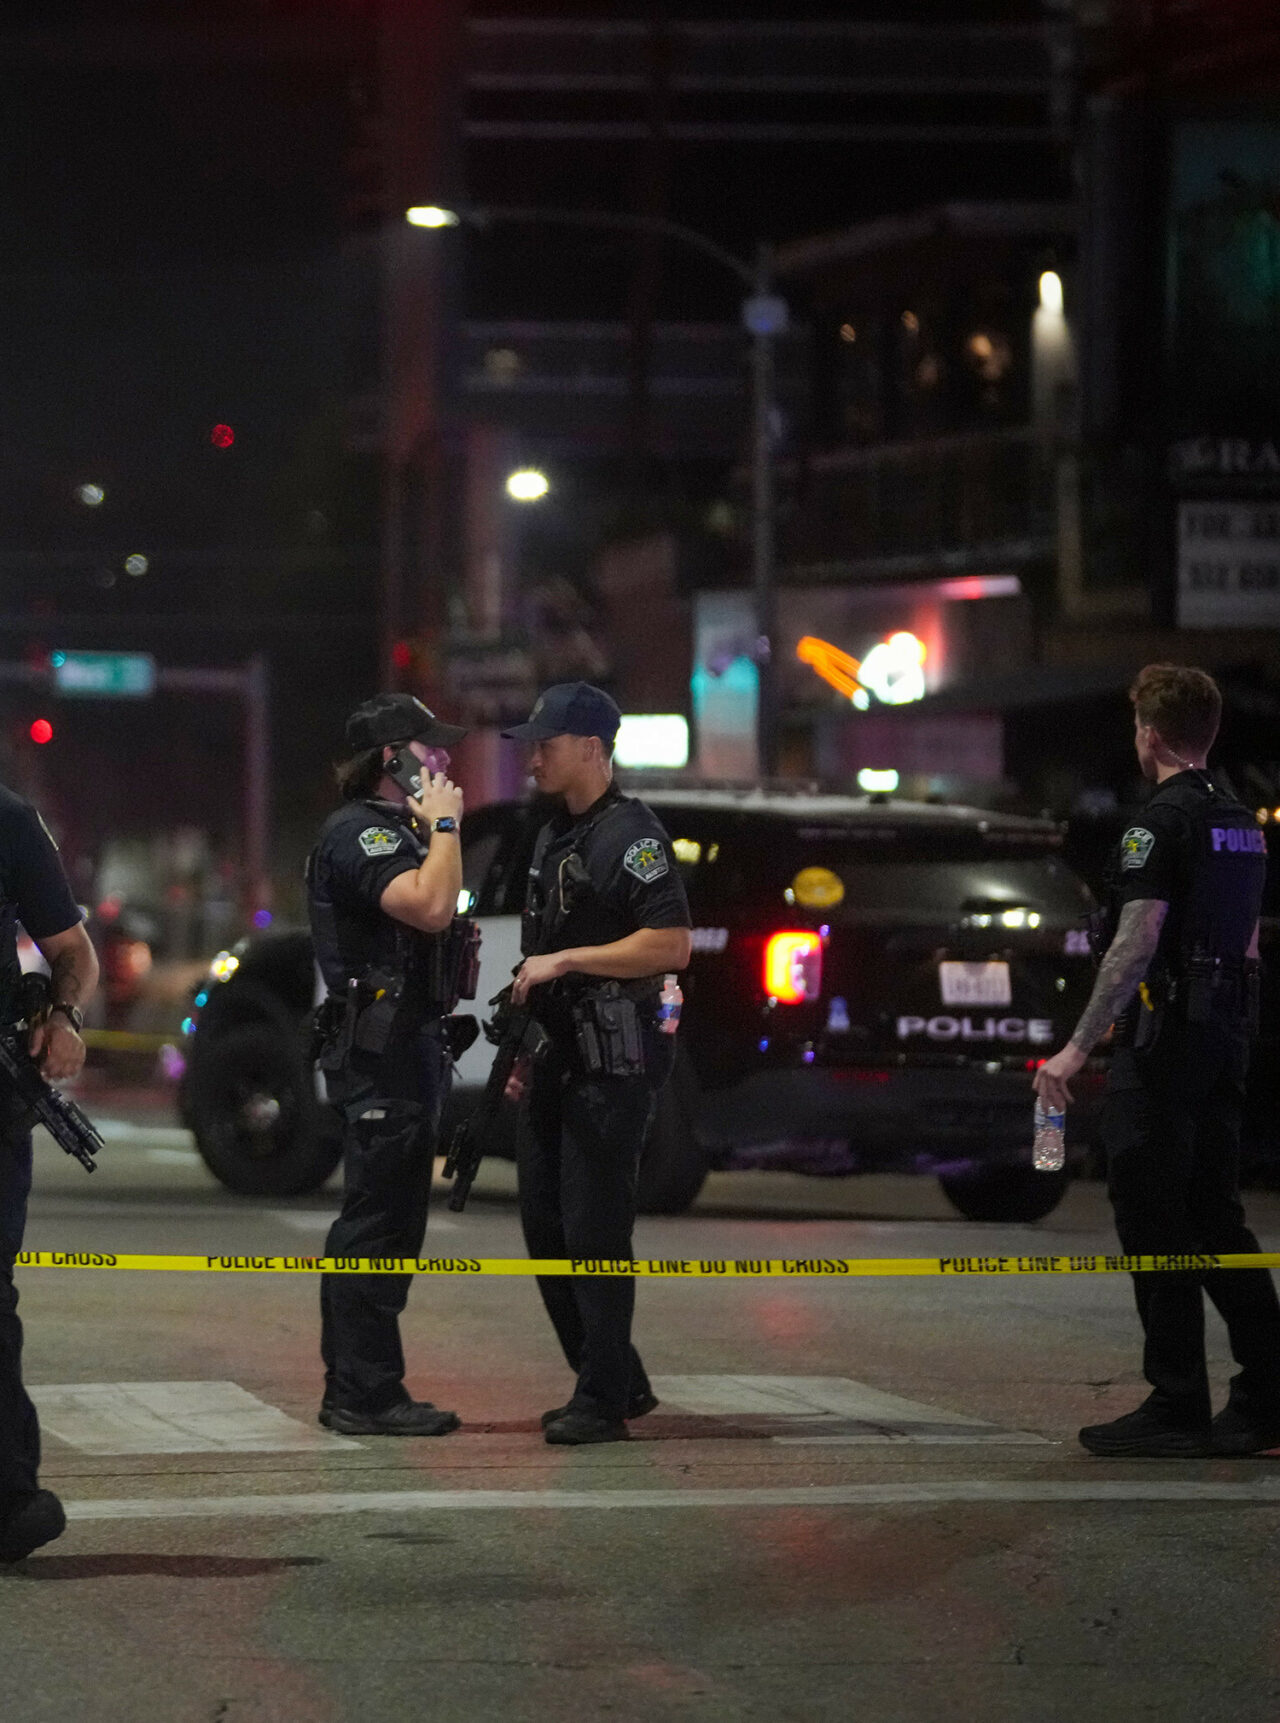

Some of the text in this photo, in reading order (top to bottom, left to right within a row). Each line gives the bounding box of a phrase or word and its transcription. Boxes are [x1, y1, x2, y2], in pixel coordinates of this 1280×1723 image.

[896, 1014, 1055, 1045] POLICE
[208, 1256, 275, 1268] POLICE
[284, 1256, 326, 1269] LINE
[416, 1258, 481, 1272] CROSS
[571, 1259, 850, 1273] POLICE LINE DO NOT CROSS
[939, 1254, 1220, 1273] POLICE LINE DO NOT CROSS
